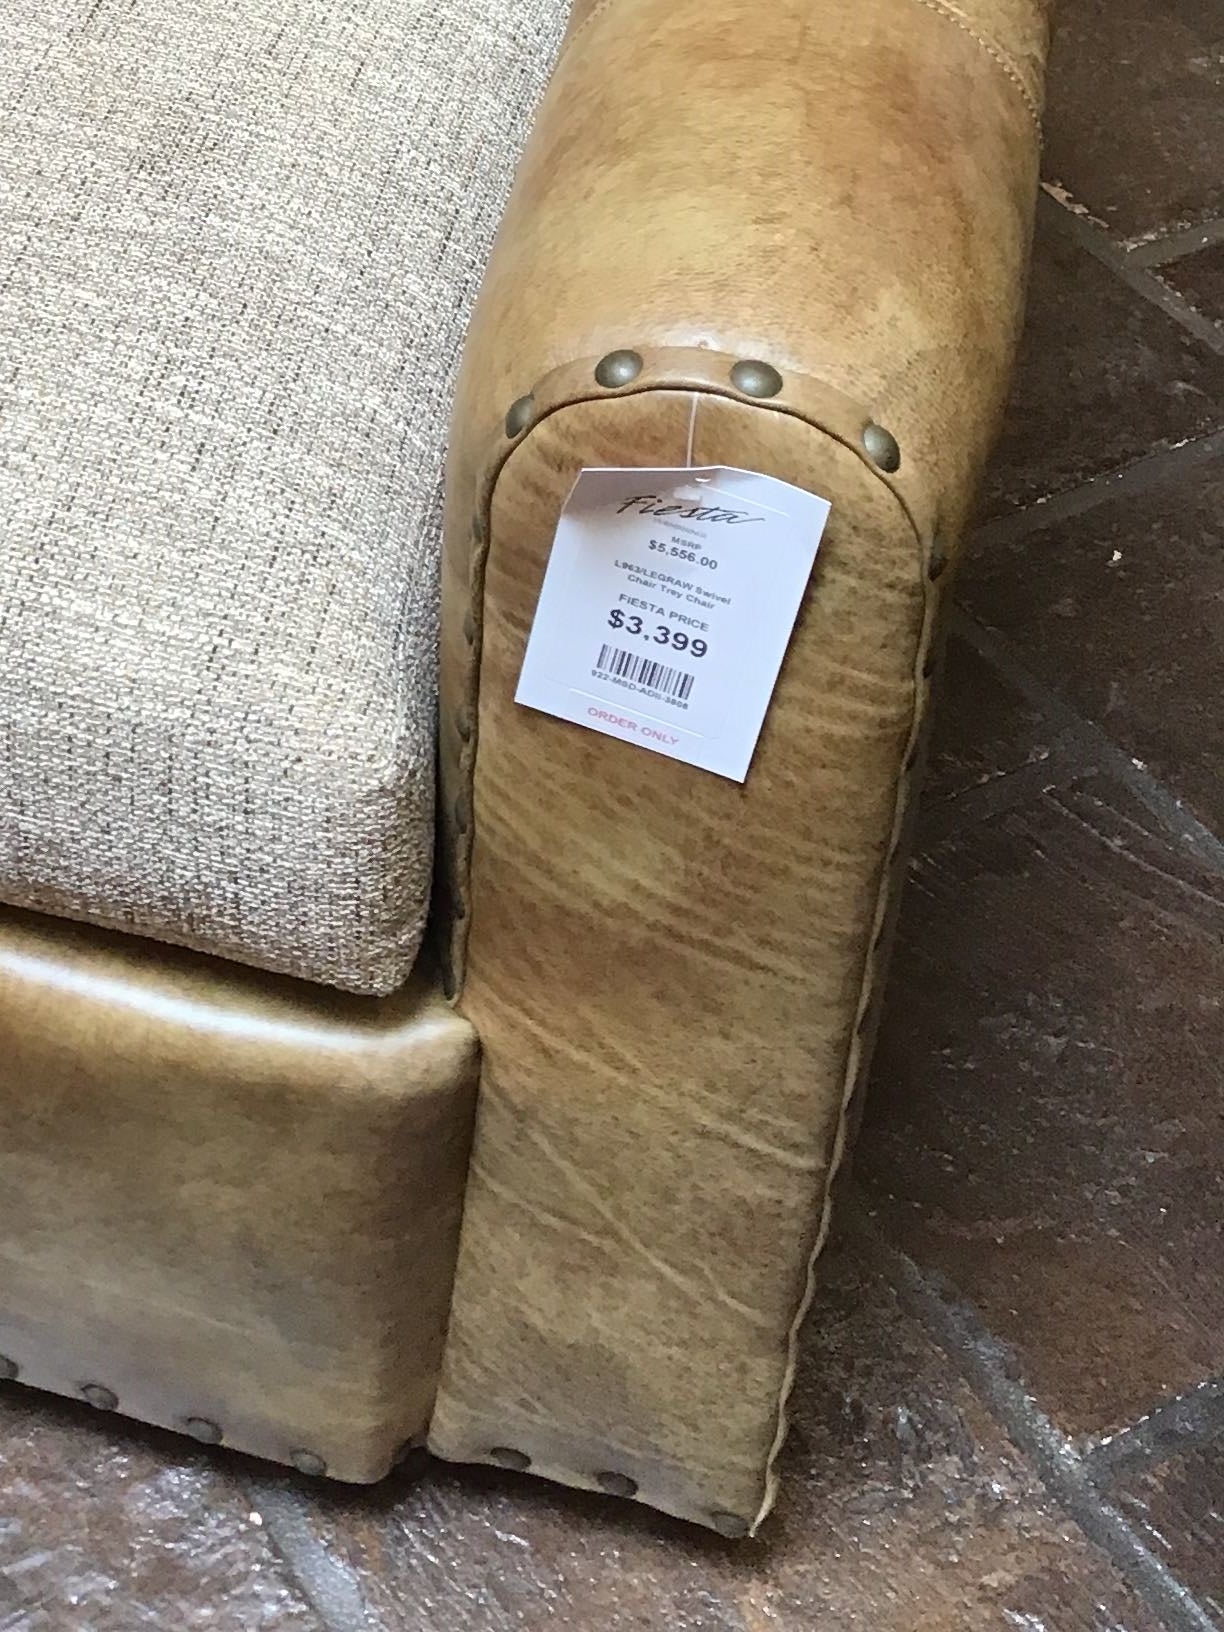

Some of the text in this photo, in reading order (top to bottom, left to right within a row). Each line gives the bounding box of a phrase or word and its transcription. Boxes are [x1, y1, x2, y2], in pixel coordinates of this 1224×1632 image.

[648, 539, 718, 570] $5,556.00
[672, 536, 702, 550] MSRP
[627, 574, 716, 609] Chair Trey Chair
[695, 586, 732, 605] Swivel
[618, 593, 710, 632] FIESTA PRICE
[607, 608, 708, 658] $3,399
[587, 706, 680, 745] ORDER ONLY
